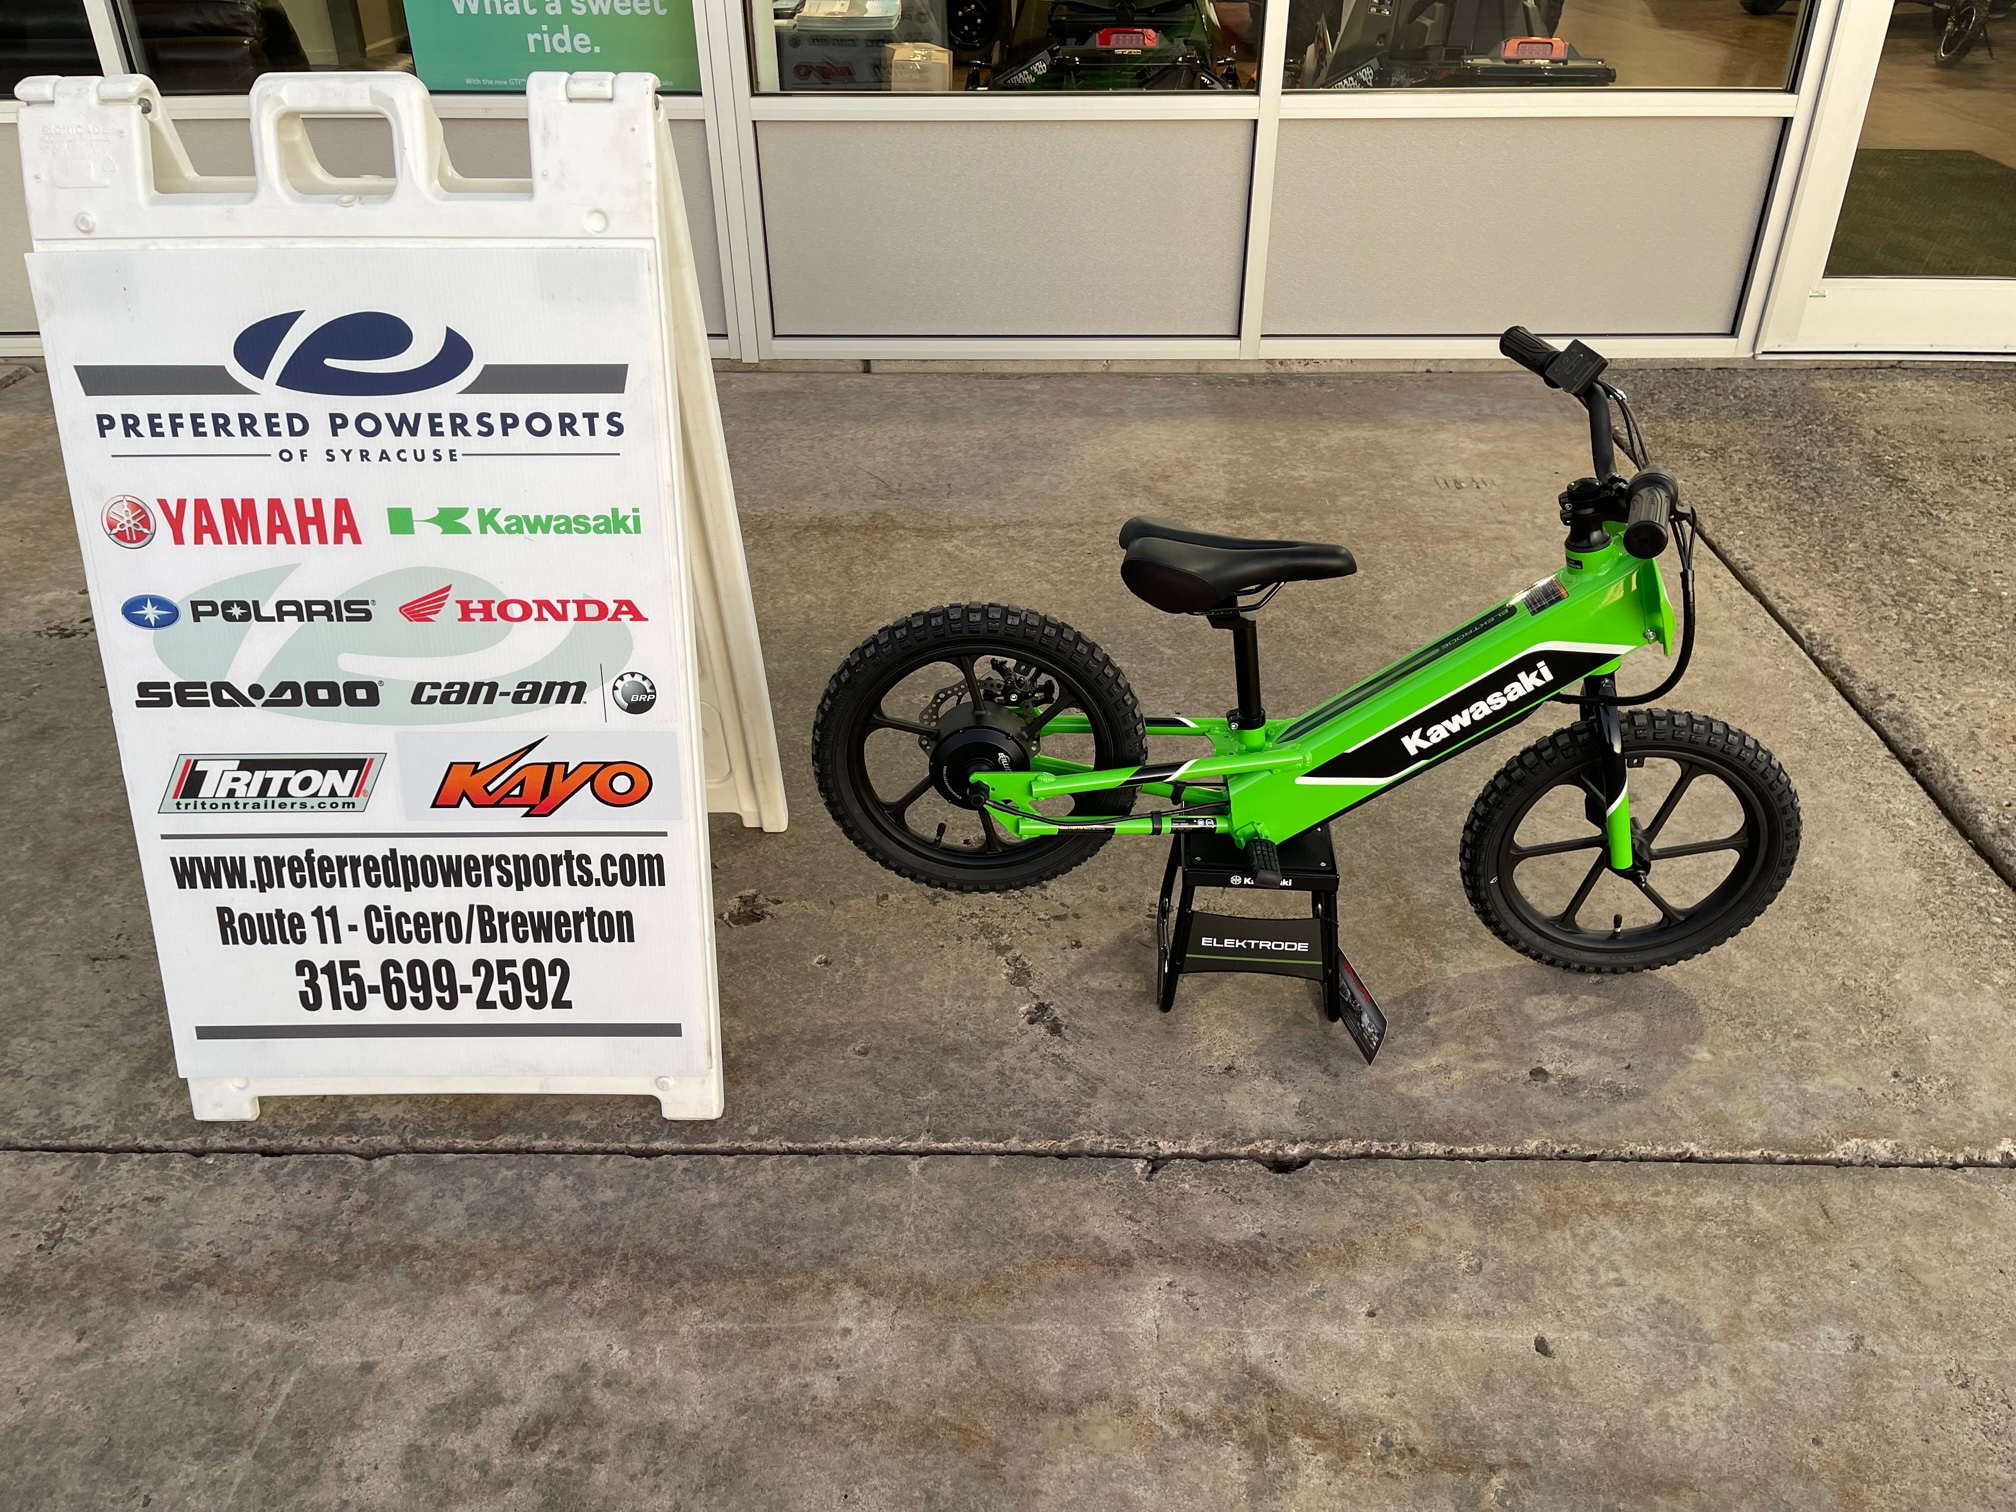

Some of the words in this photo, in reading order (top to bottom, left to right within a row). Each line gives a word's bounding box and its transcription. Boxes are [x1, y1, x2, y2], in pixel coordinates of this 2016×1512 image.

[452, 0, 538, 15] What
[545, 0, 563, 15] a
[571, 0, 668, 16] sweet
[527, 24, 601, 54] ride.
[96, 412, 310, 438] PREFERRED
[329, 411, 625, 438] POWERSPORTS
[278, 449, 309, 463] OF
[325, 448, 459, 463] SYRACUSE
[157, 497, 363, 545] YAMAHA
[478, 507, 642, 535] Kawasaki
[456, 598, 649, 622] HONDA
[1441, 608, 1509, 650] ELEKTRODE
[411, 679, 588, 705] can-am
[630, 694, 656, 702] BRP
[1400, 660, 1554, 756] Kawasaki
[195, 759, 359, 798] TRITON
[430, 735, 654, 818] KAYO
[175, 799, 356, 811] tritontrailers.com
[170, 847, 666, 893] www.preferredpowersports.com
[215, 905, 307, 946] Route
[310, 905, 342, 945] 11
[364, 903, 635, 945] Cicero/Brewerton
[1201, 936, 1310, 952] ELEKTRODE
[295, 957, 573, 1012] 315-699-2592
